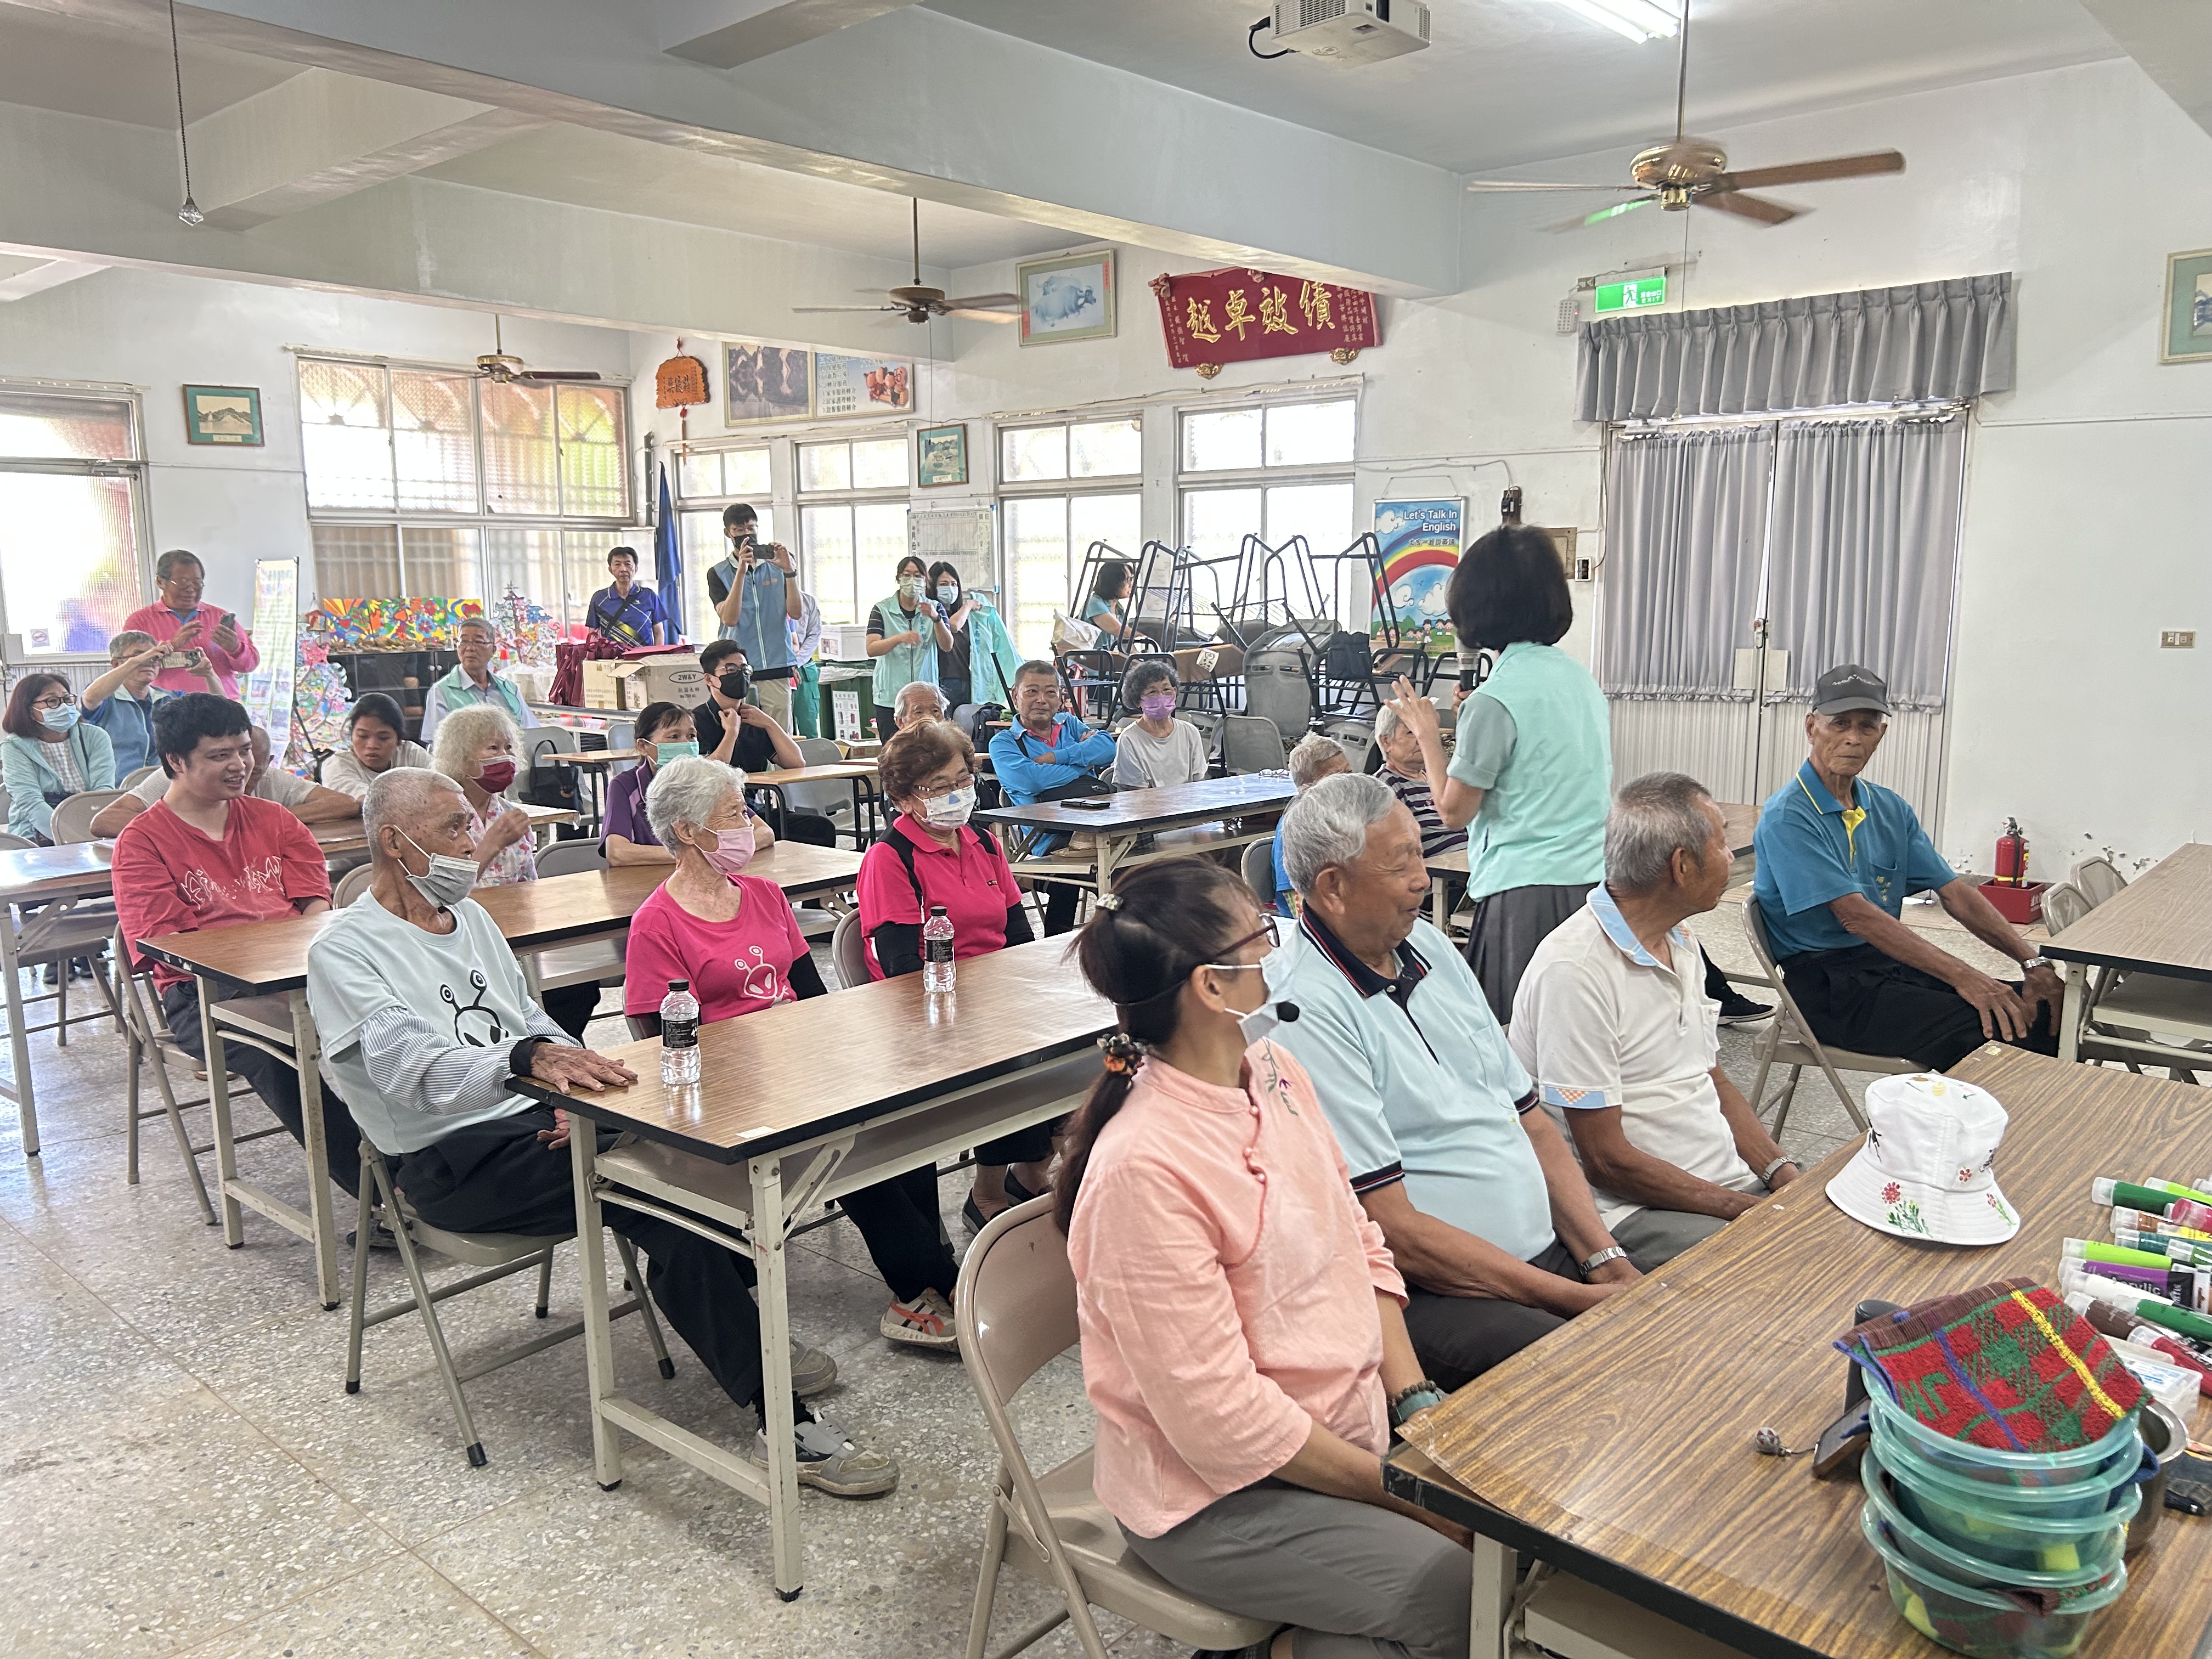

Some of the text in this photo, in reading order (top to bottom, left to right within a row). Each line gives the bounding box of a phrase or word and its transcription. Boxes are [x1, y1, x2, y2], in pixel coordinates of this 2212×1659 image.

[1404, 509, 1457, 520] Let's Talk In
[1422, 521, 1456, 534] English
